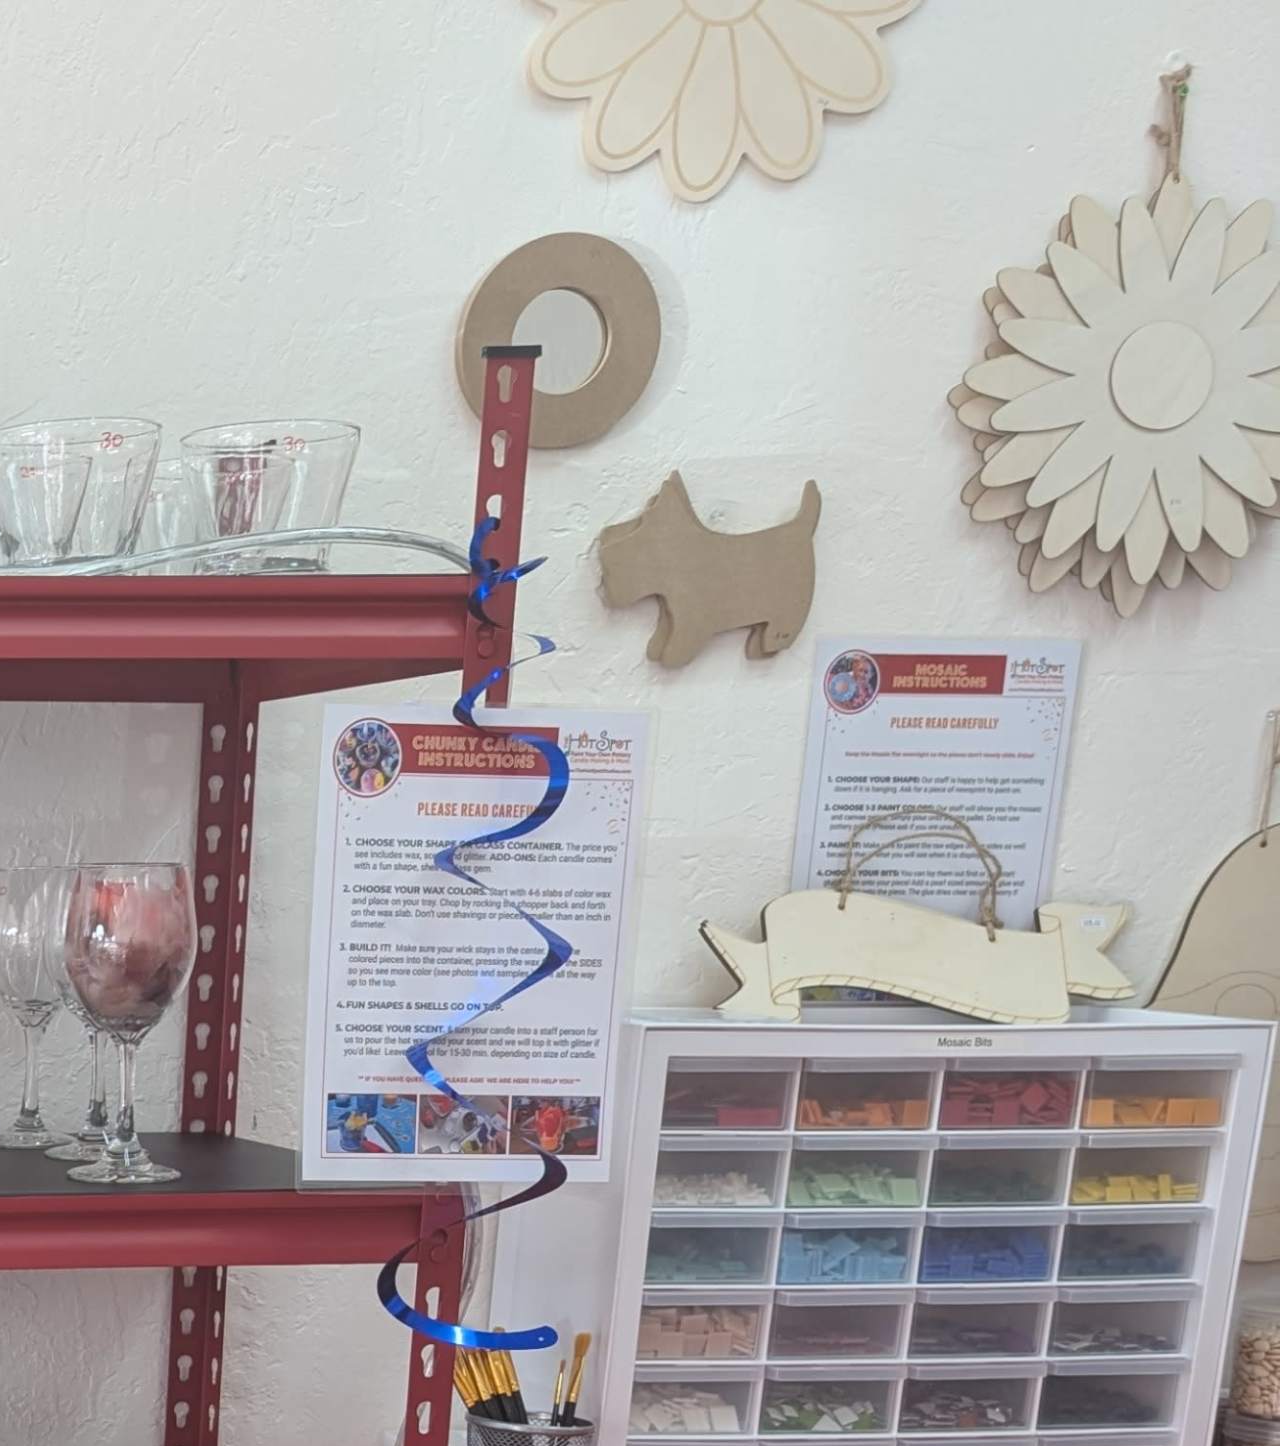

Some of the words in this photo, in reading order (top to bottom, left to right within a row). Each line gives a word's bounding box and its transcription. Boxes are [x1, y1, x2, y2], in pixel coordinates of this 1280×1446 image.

[915, 664, 968, 677] MOSAIC
[892, 677, 987, 689] INSTRUCTIONS
[890, 717, 924, 729] PLEASE
[925, 717, 949, 729] READ
[950, 717, 999, 729] CAREFULLY
[412, 735, 478, 751] CHUNKY
[418, 752, 535, 768] INSTRUCTIONS
[417, 803, 457, 816] PLEASE
[461, 803, 489, 817] READ
[507, 841, 563, 851] CONTAINER.
[352, 884, 392, 894] CHOOSE
[394, 885, 421, 895] YOUR
[422, 886, 446, 895] WAX
[447, 885, 489, 896] COLORS.
[344, 1024, 383, 1033] CHOOSE
[386, 1024, 412, 1033] YOUR
[414, 1024, 446, 1034] SCENT.
[938, 1038, 972, 1047] Mosaic
[974, 1037, 992, 1047] Bits
